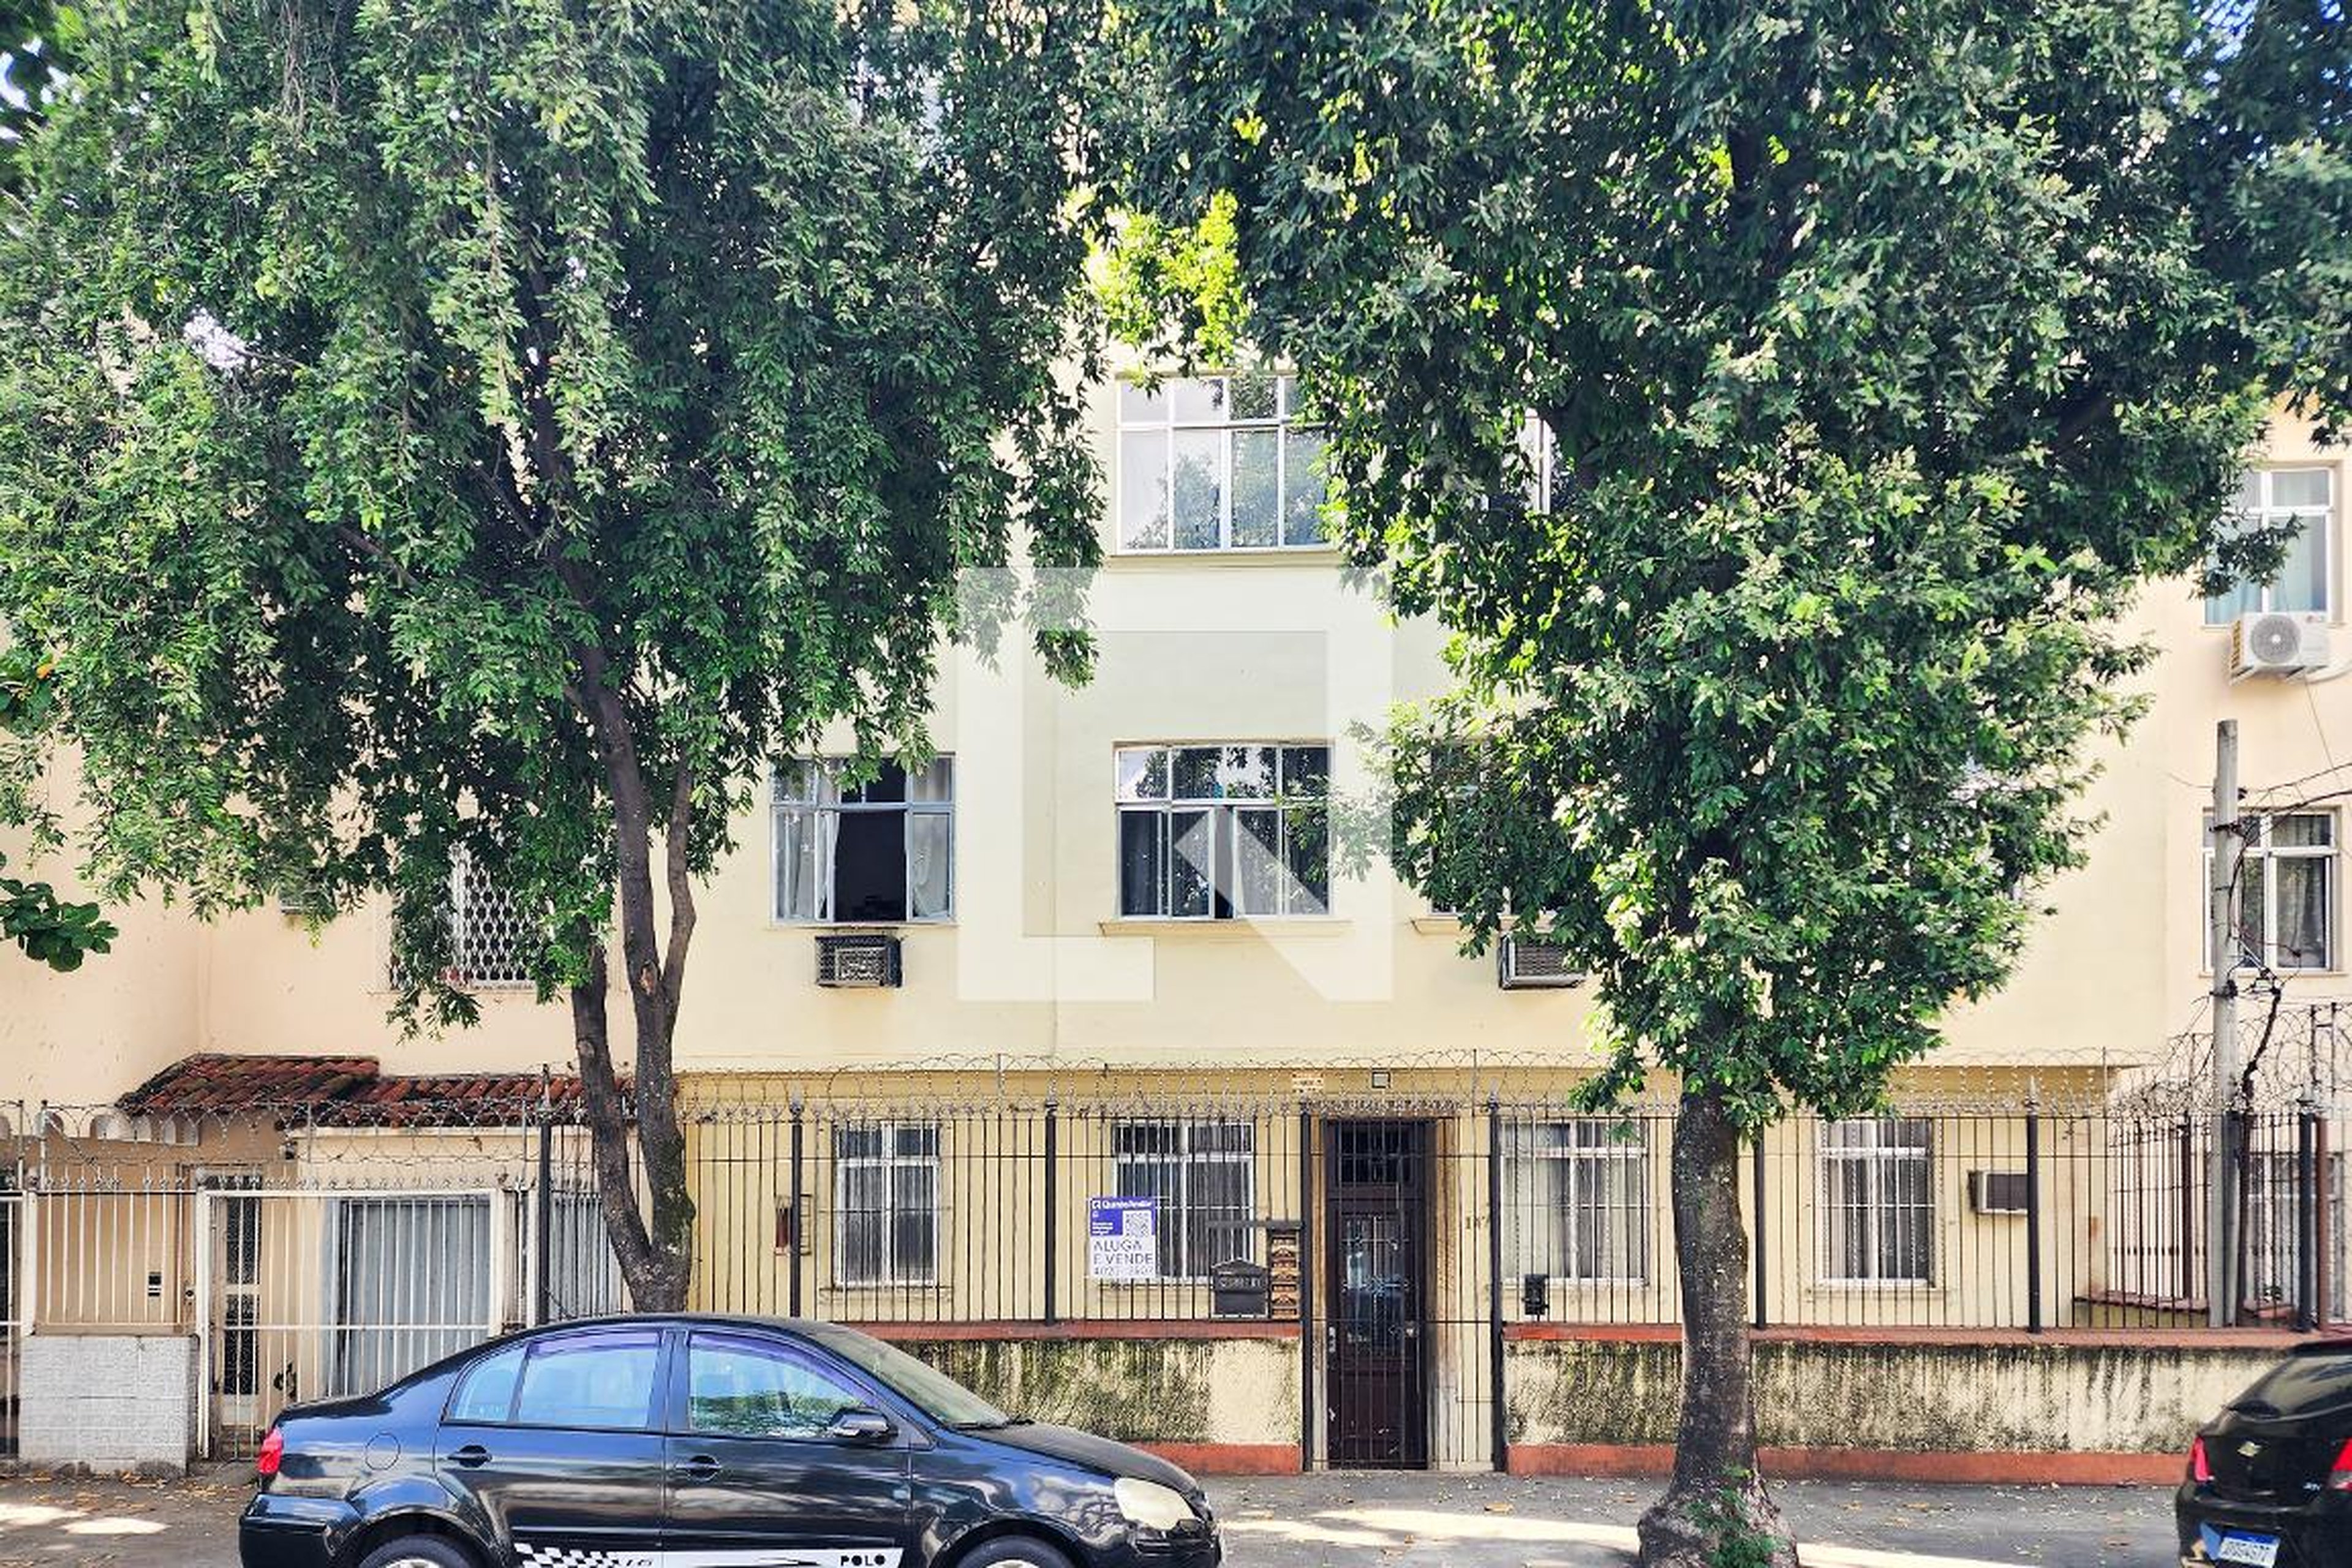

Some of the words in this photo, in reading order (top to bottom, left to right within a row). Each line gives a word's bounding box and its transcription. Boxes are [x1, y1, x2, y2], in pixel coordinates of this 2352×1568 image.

[1094, 1239, 1142, 1252] ALUGA
[1104, 1253, 1153, 1265] VENDE
[840, 1554, 886, 1567] POLO
